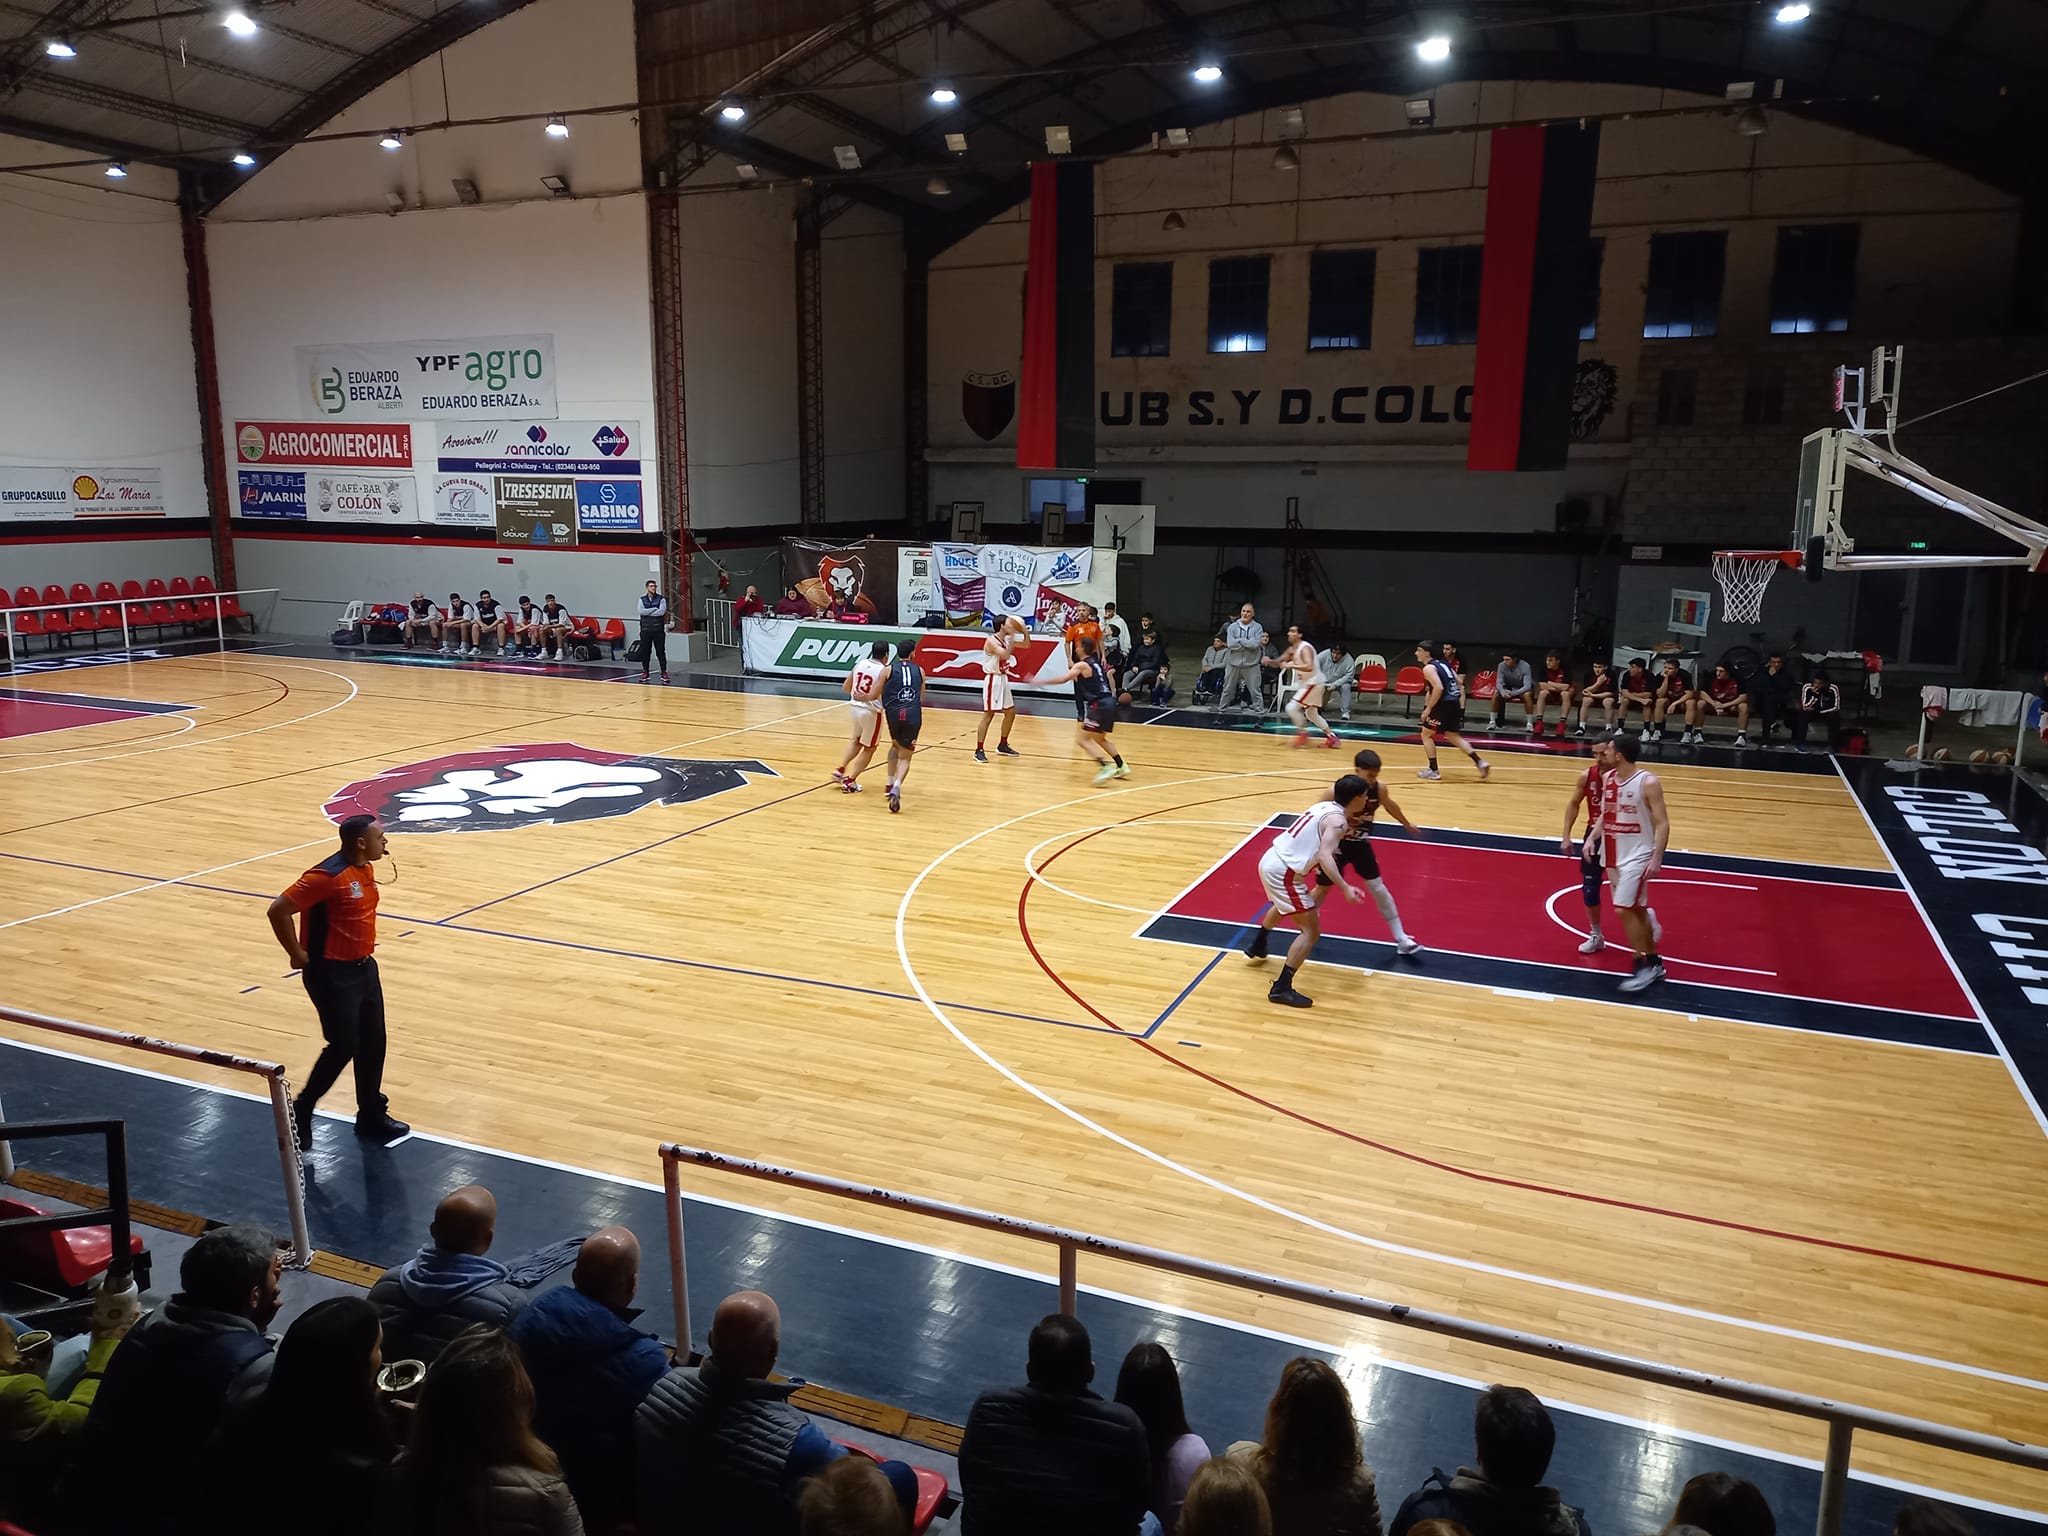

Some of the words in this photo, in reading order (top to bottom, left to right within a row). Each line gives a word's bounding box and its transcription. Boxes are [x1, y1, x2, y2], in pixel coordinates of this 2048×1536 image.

[415, 354, 461, 372] YPF
[464, 348, 543, 391] agro
[348, 370, 399, 384] EDUARDO
[350, 385, 402, 401] BERAZA
[377, 402, 403, 410] ALBERTI
[422, 396, 478, 410] EDUARDO
[480, 393, 528, 408] BERAZA
[268, 432, 403, 459] AGROCOMERCIAL
[504, 443, 571, 456] sannicolas
[475, 462, 502, 470] Pellegrini
[510, 462, 537, 471] Chivilcoy
[363, 484, 381, 493] BAR
[442, 478, 460, 488] CUEVA
[1, 491, 67, 501] GRUPOCASULLO
[96, 487, 116, 500] Las
[504, 483, 573, 499] TRESESENTA
[337, 494, 382, 509] COLÓN
[580, 504, 639, 518] SABINO
[856, 671, 874, 694] 13
[901, 666, 912, 686] 11
[1287, 811, 1314, 838] 11
